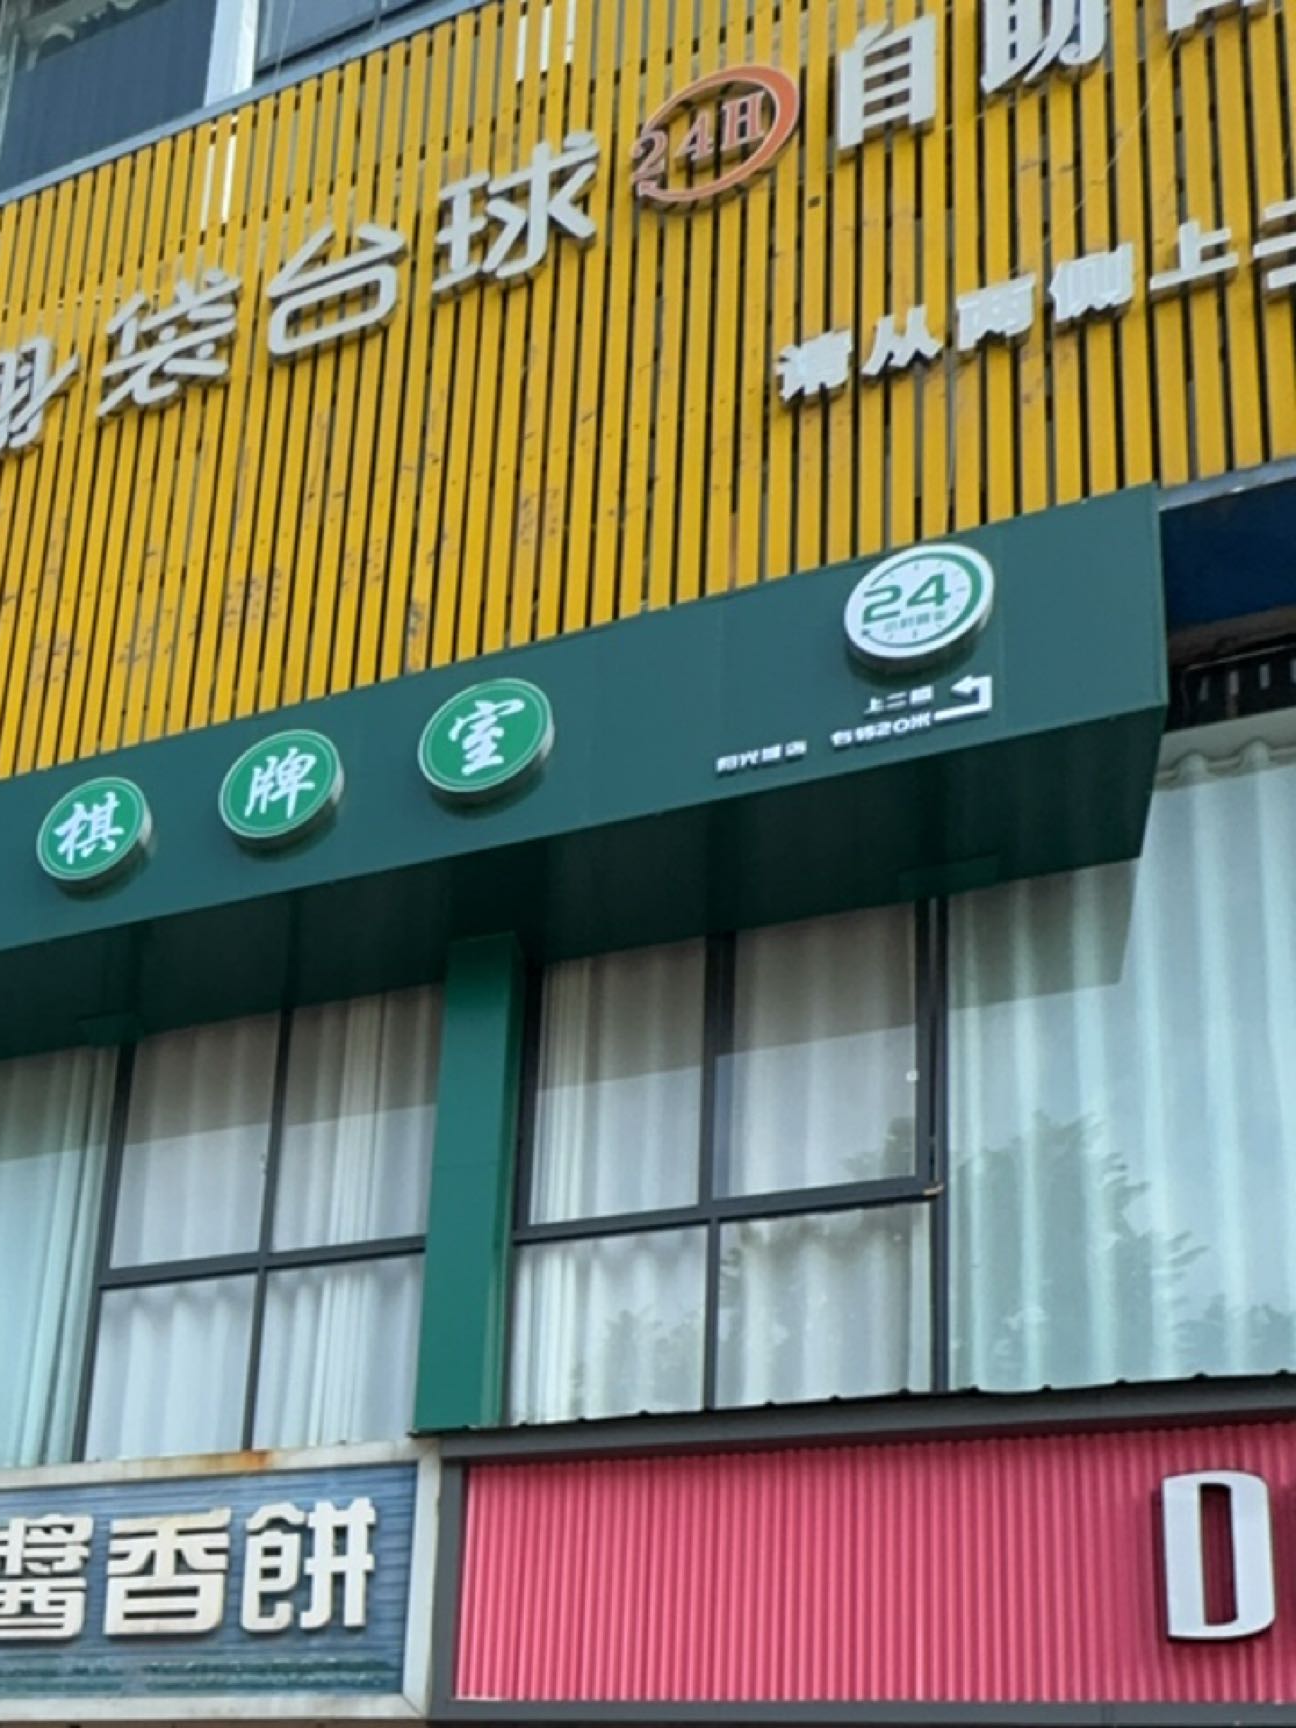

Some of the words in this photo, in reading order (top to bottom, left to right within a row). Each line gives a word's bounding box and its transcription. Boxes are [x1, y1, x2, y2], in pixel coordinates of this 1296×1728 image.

[631, 91, 766, 182] 24H
[861, 573, 952, 625] 24
[54, 697, 526, 865] 棋牌室
[1161, 1469, 1276, 1641] D
